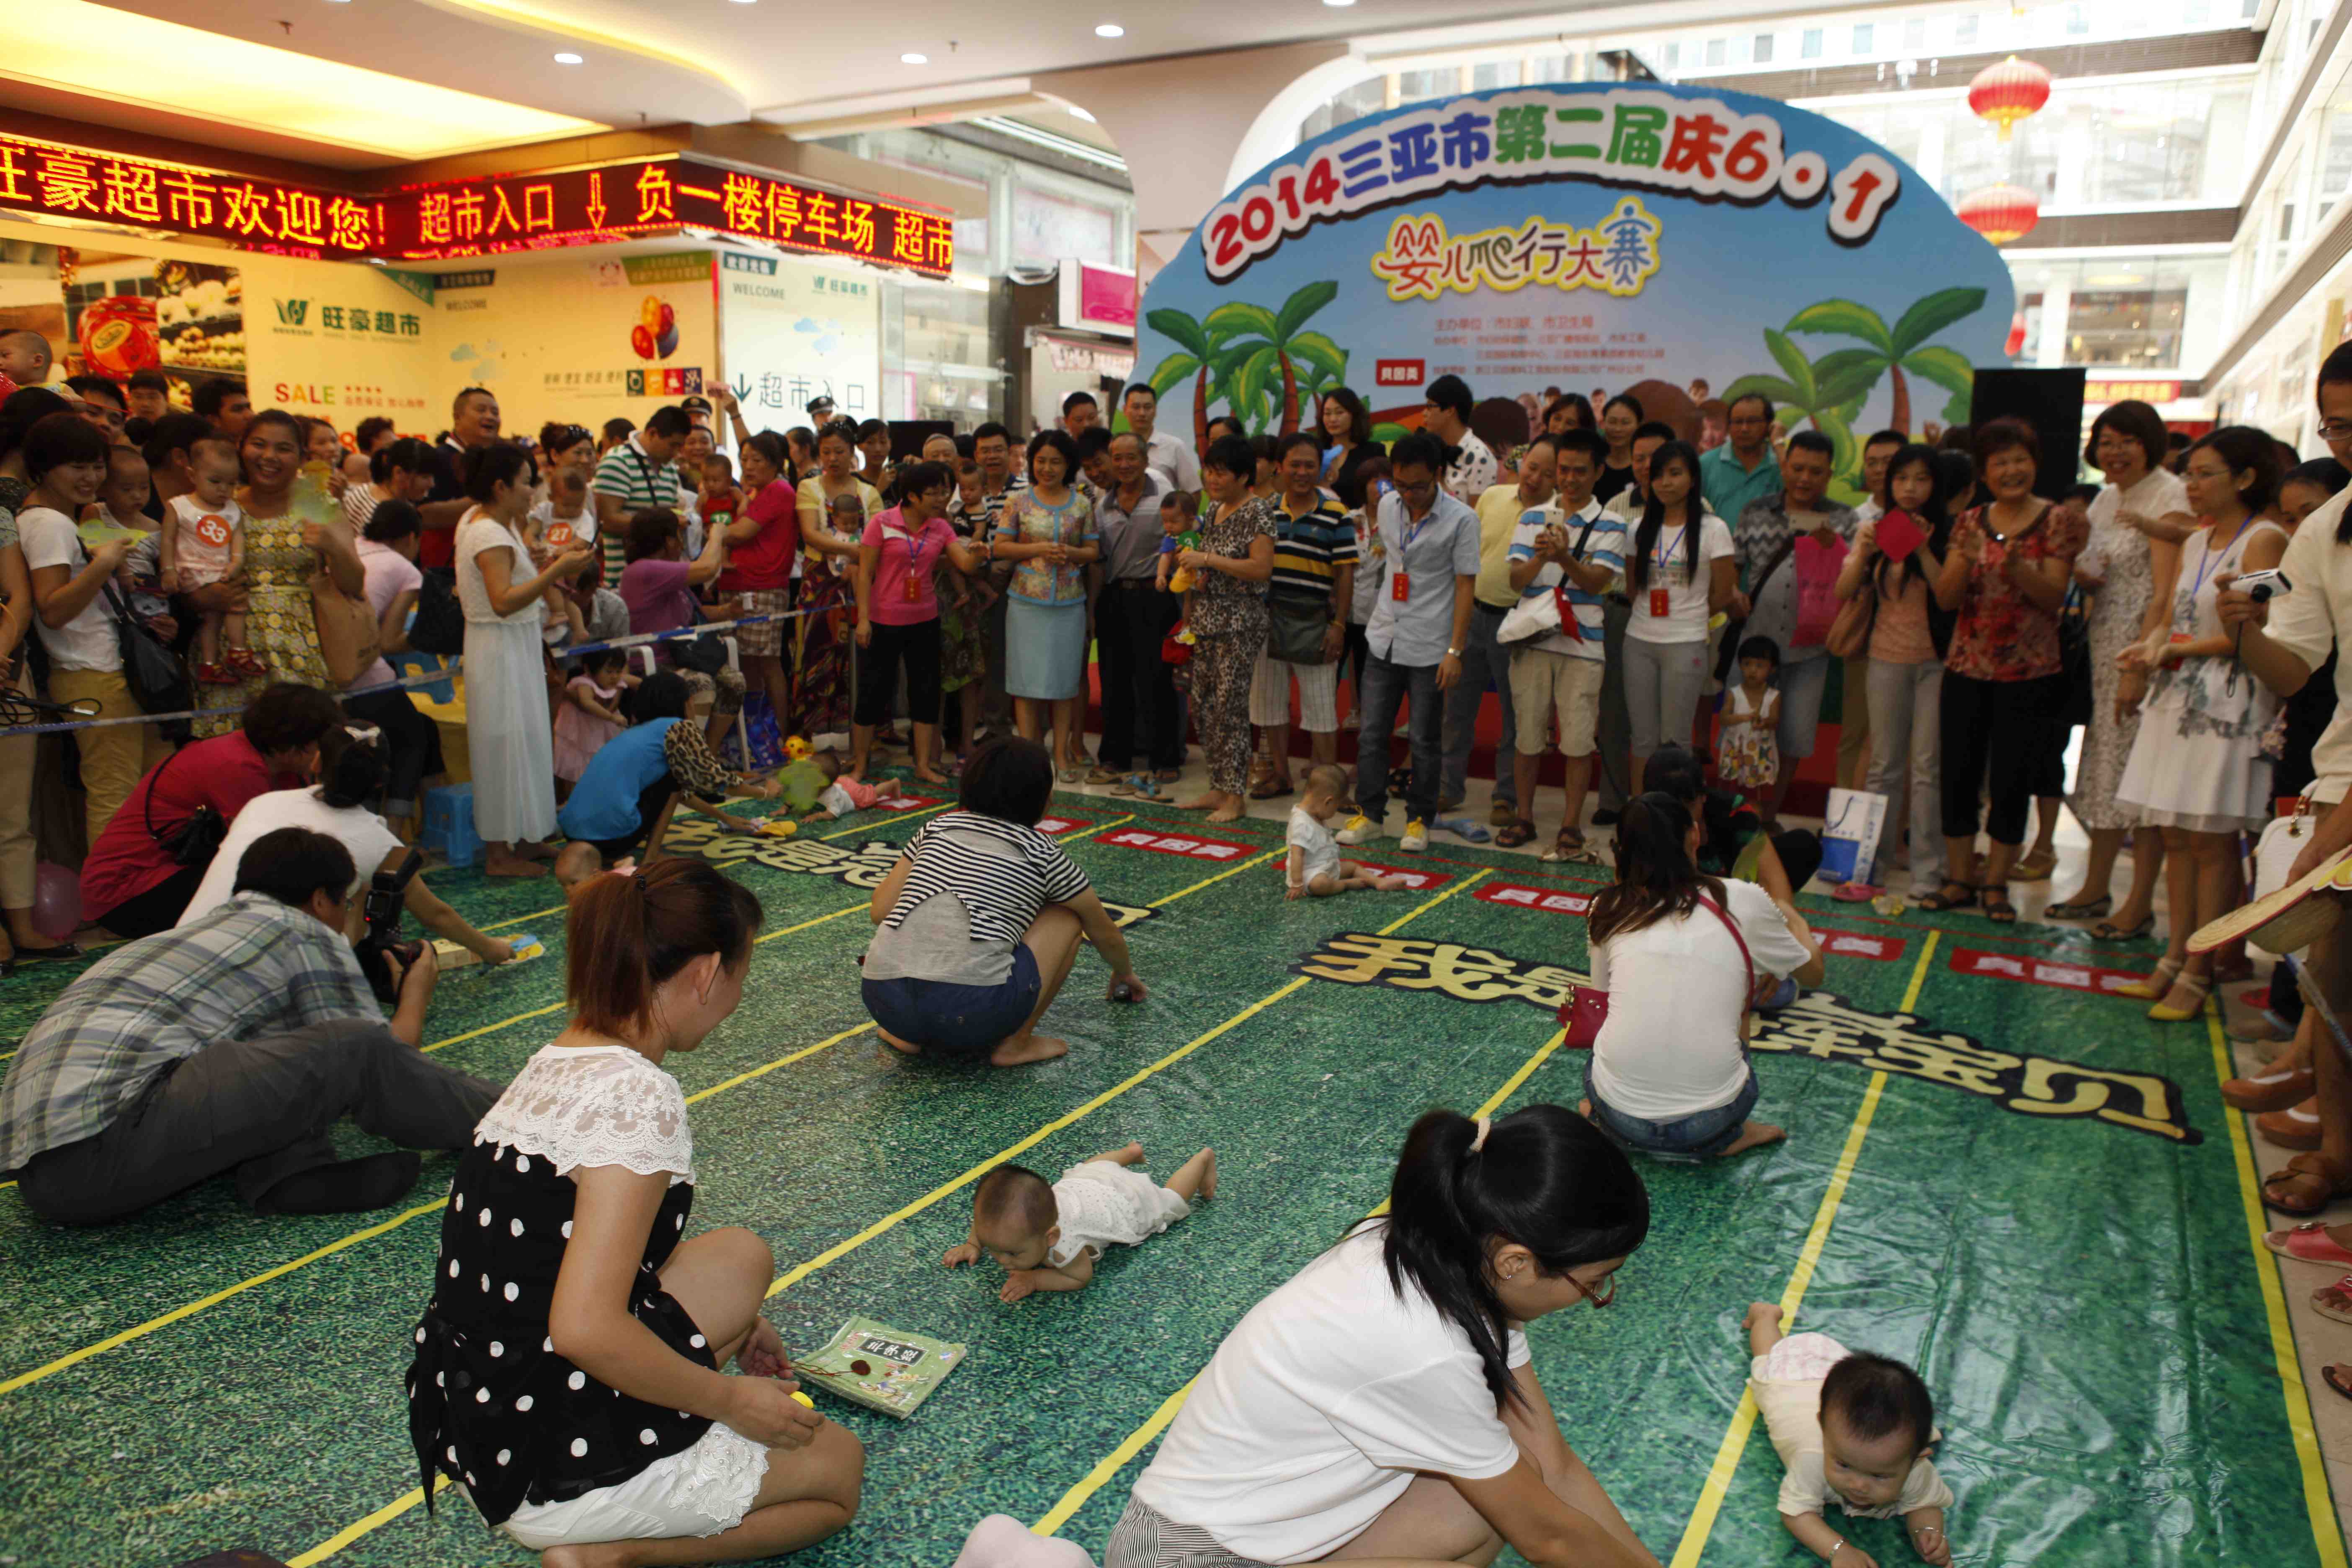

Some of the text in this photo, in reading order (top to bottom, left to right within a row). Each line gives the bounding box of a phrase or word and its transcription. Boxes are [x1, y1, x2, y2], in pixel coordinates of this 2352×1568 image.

[420, 163, 953, 268] 超市入口 负一楼停车场 超市
[732, 283, 786, 299] WELCOME
[322, 305, 420, 336] 旺豪超市
[275, 383, 336, 405] SALE
[201, 520, 227, 543] 33
[550, 528, 569, 541] 27
